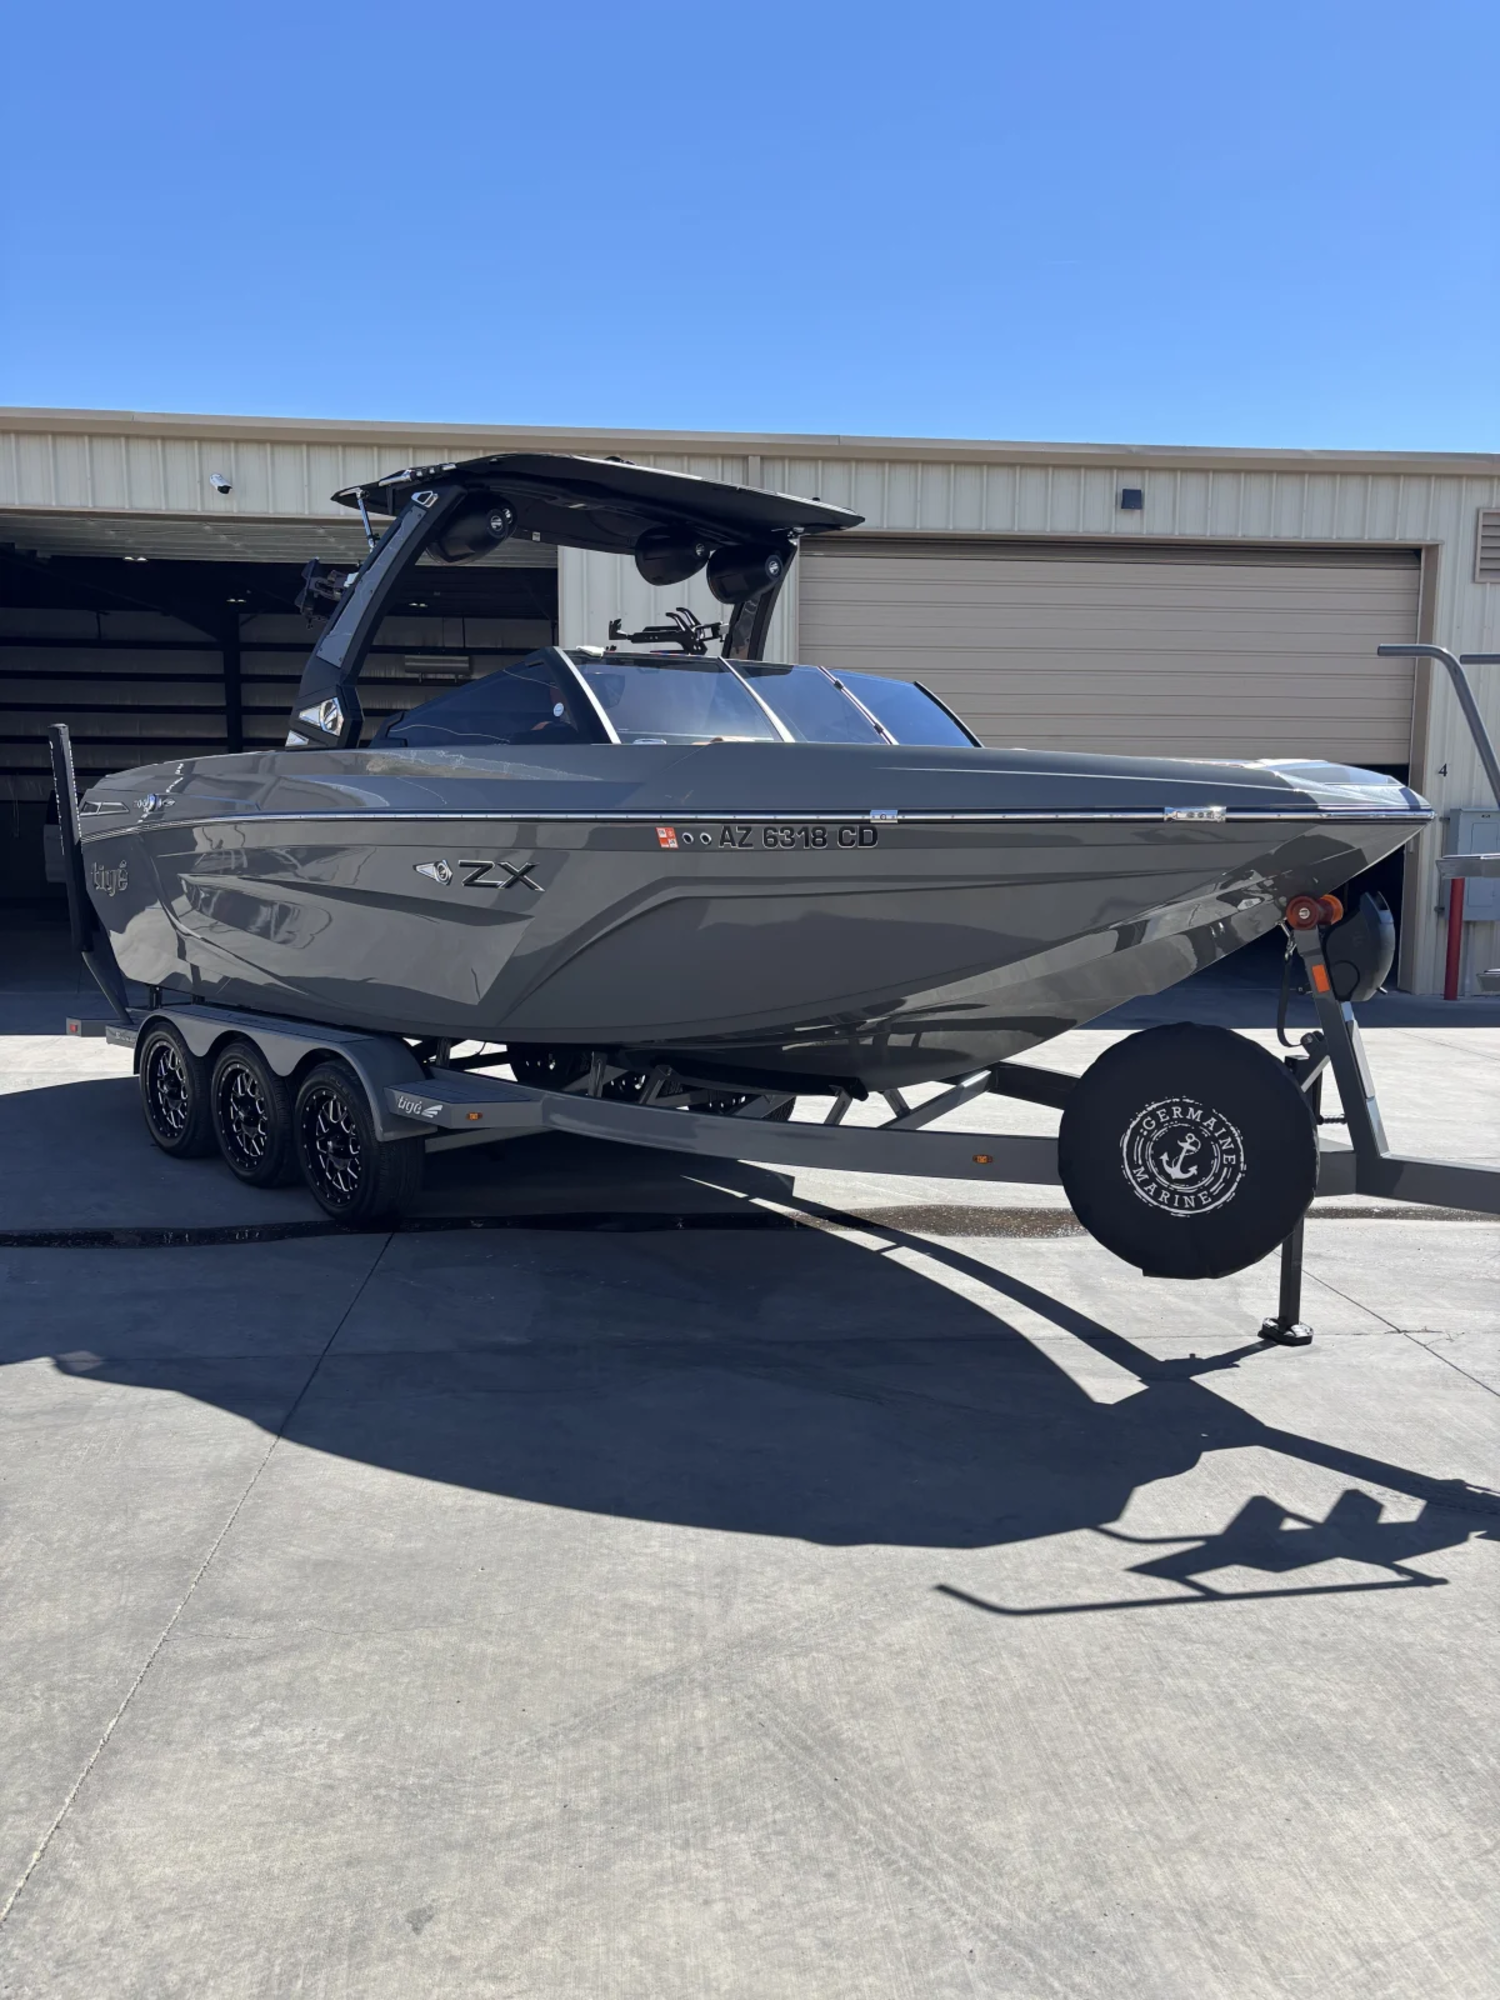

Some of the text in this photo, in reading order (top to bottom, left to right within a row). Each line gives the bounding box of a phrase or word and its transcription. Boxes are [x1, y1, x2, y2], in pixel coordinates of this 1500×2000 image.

[1438, 763, 1448, 777] 4
[718, 825, 878, 850] AZ 6318 CD
[458, 859, 545, 892] ZX
[1142, 1106, 1237, 1165] GERMAINE
[1132, 1166, 1212, 1208] MARINE
